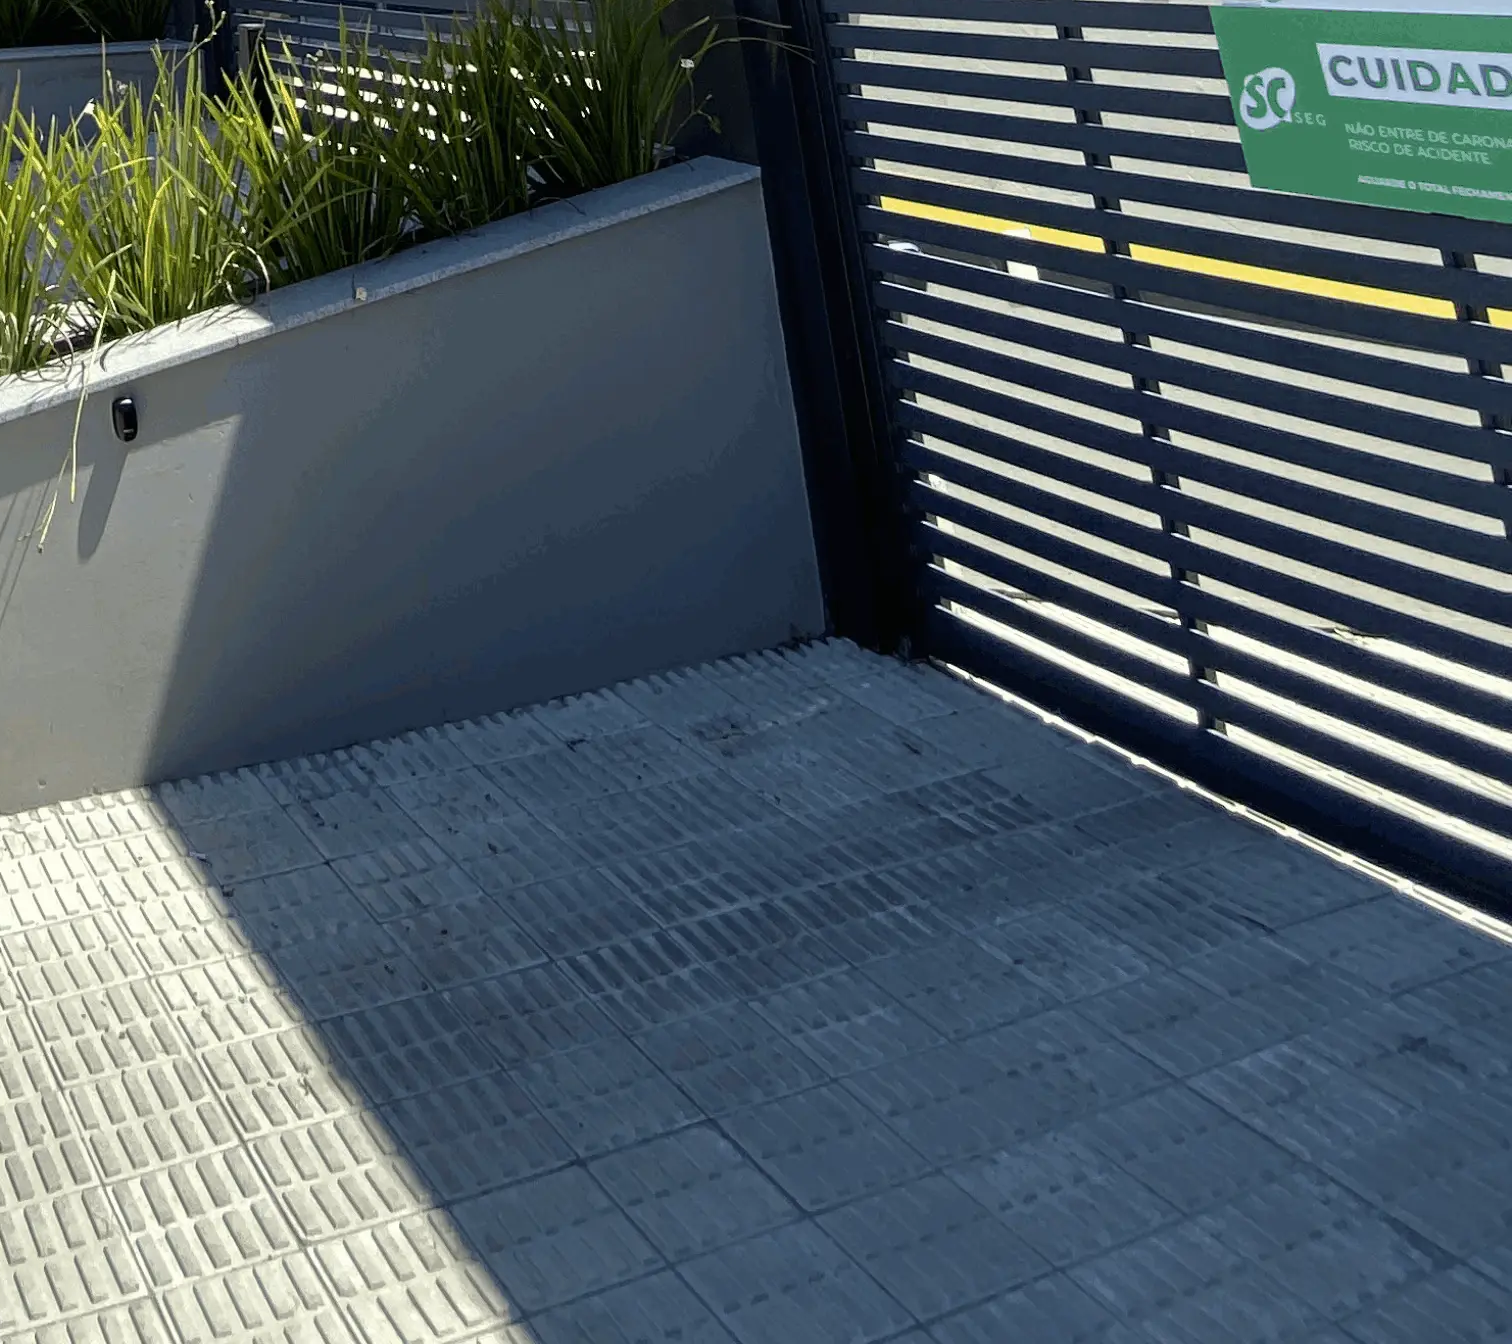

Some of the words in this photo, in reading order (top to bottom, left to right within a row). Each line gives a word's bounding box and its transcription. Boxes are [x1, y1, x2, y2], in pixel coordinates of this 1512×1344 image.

[1245, 74, 1289, 121] SC
[1293, 110, 1327, 127] SEG
[1344, 121, 1376, 137] NÃO
[1378, 125, 1425, 142] ENTRE
[1427, 130, 1449, 144] DE
[1348, 138, 1390, 154] RISCO
[1393, 143, 1414, 157] DE
[1417, 147, 1493, 165] ACIDENTE
[1418, 181, 1452, 195] TOTAL
